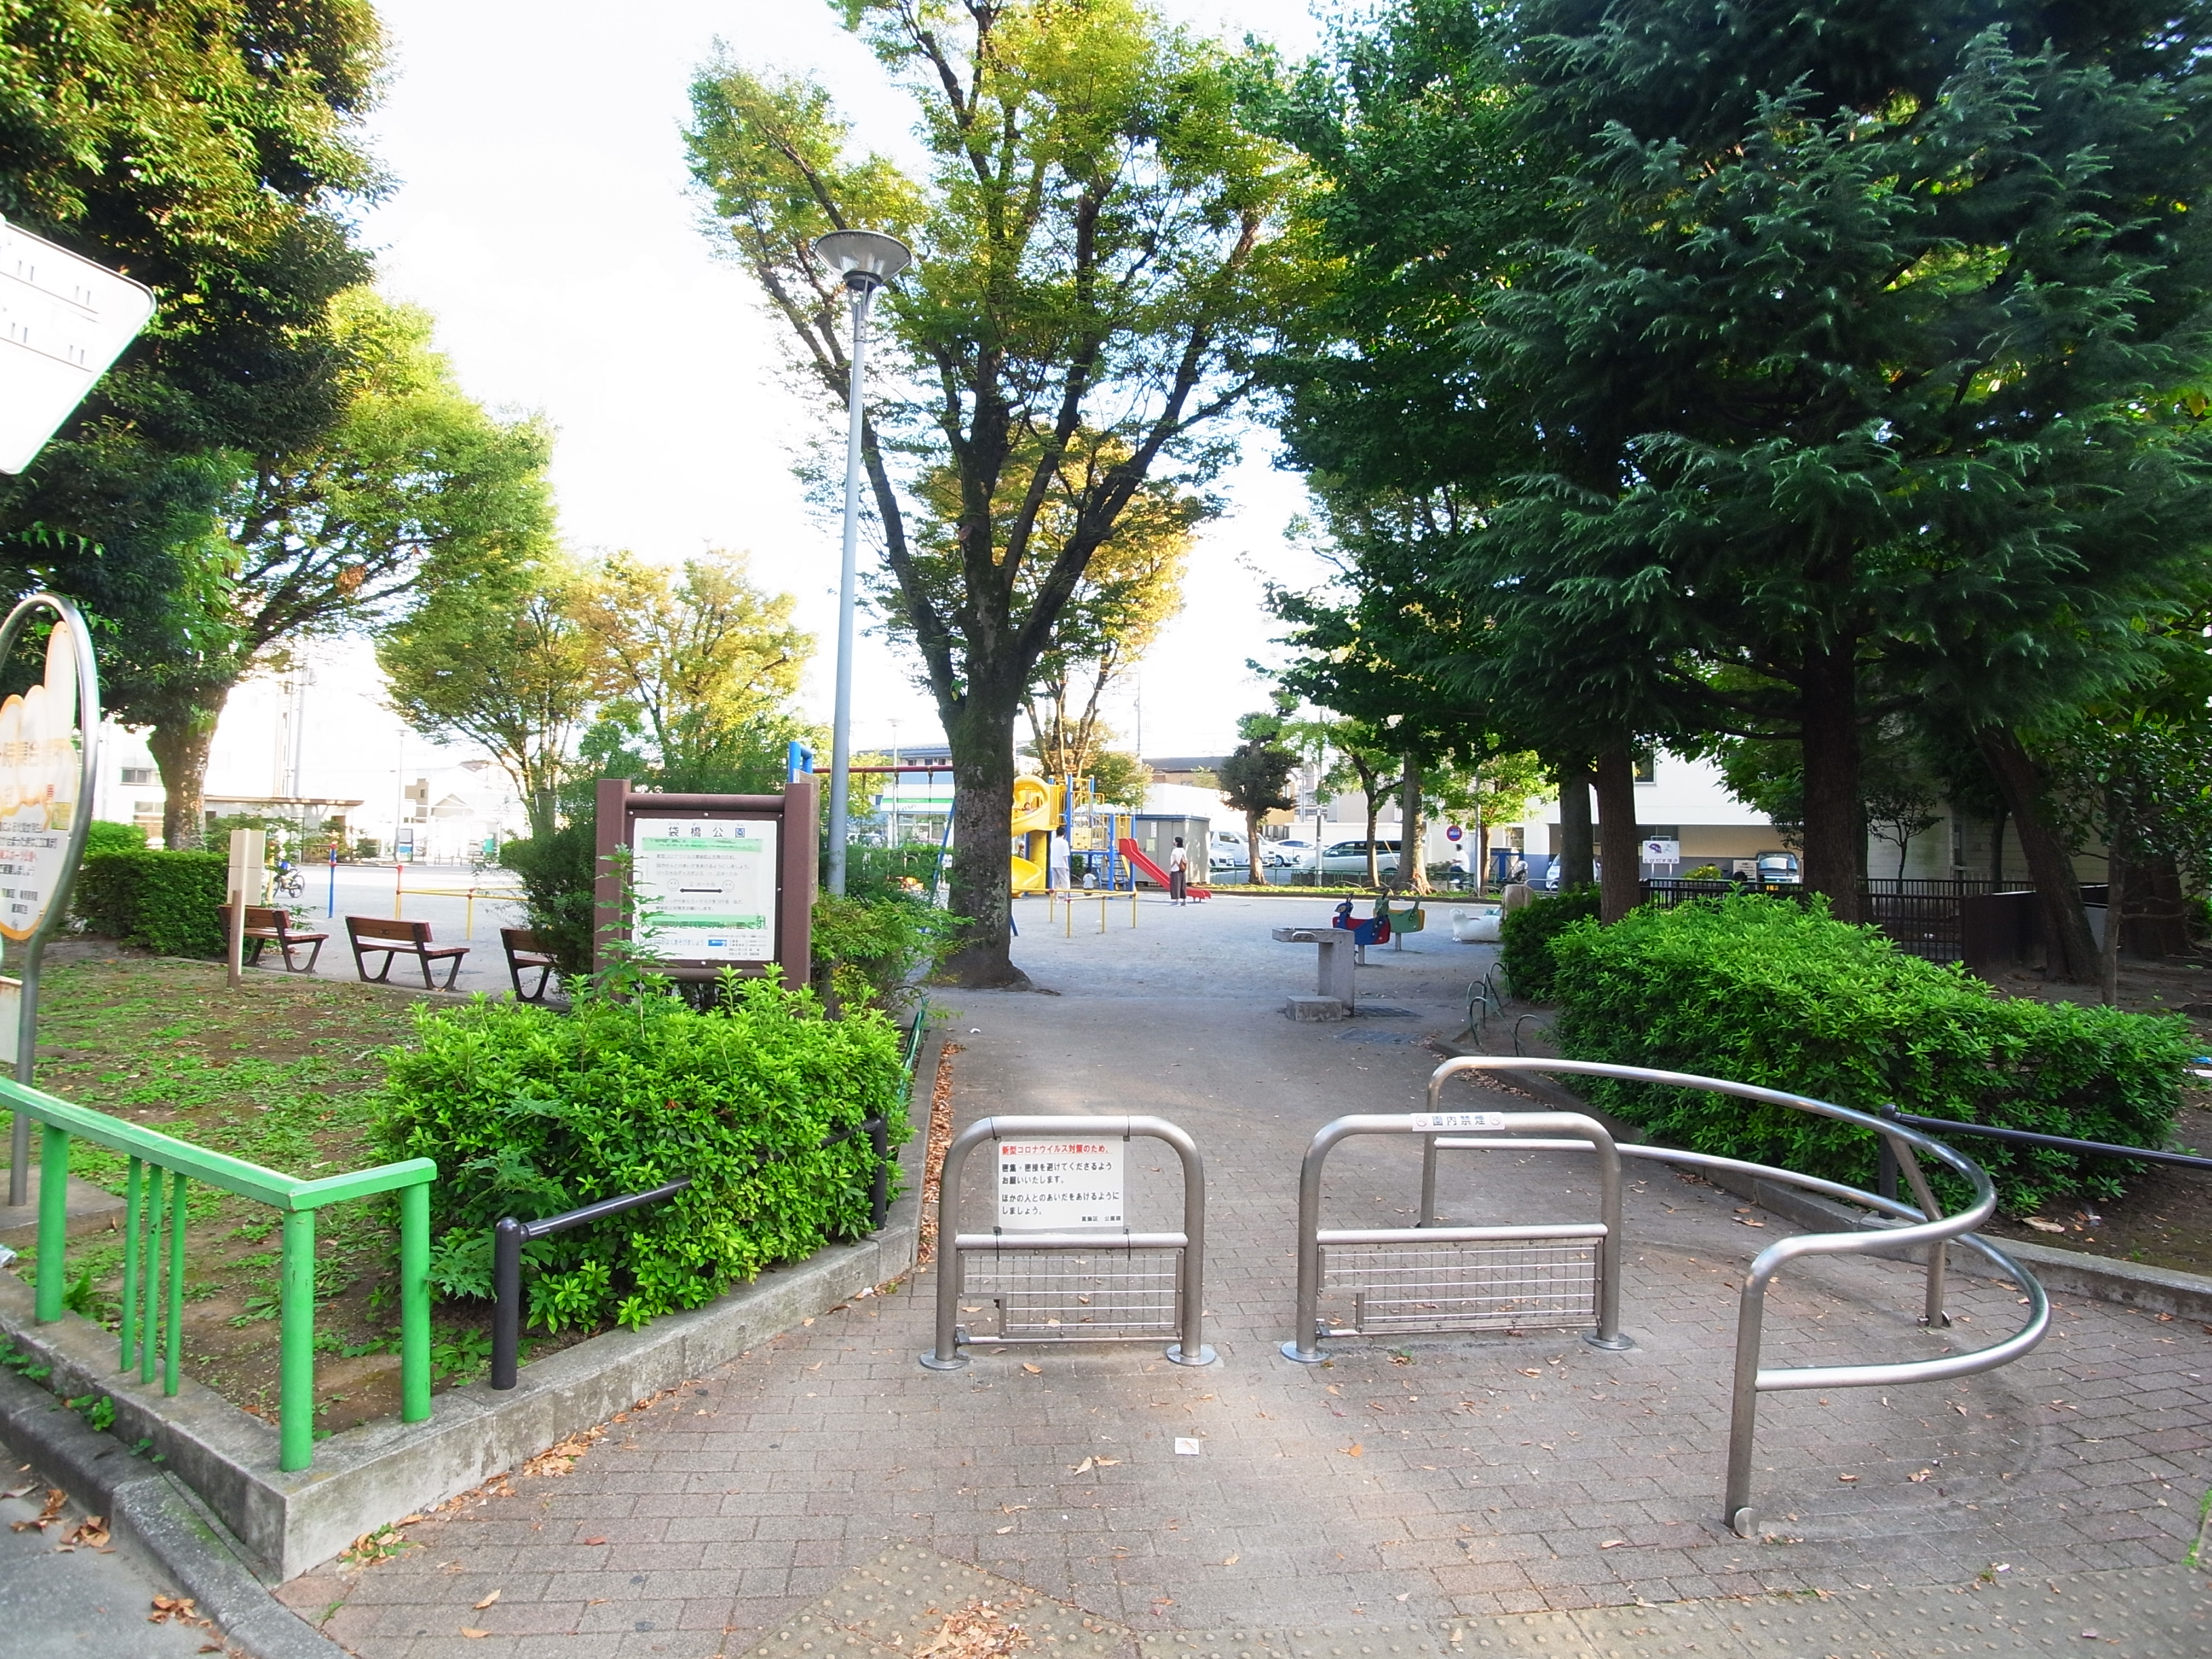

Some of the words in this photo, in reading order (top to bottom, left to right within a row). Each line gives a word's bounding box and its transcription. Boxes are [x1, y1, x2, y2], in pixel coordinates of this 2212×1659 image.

[1432, 1115, 1486, 1126] 園内禁煙
[1002, 1144, 1109, 1155] 新型コロナウイルス対策のため、
[1002, 1162, 1112, 1172] 密集・密接を避けてくださるよう
[1002, 1175, 1064, 1185] お願いいたします。
[1002, 1191, 1119, 1203] ほかの人とのあいだをあけるように
[1002, 1206, 1042, 1215] しましょう。
